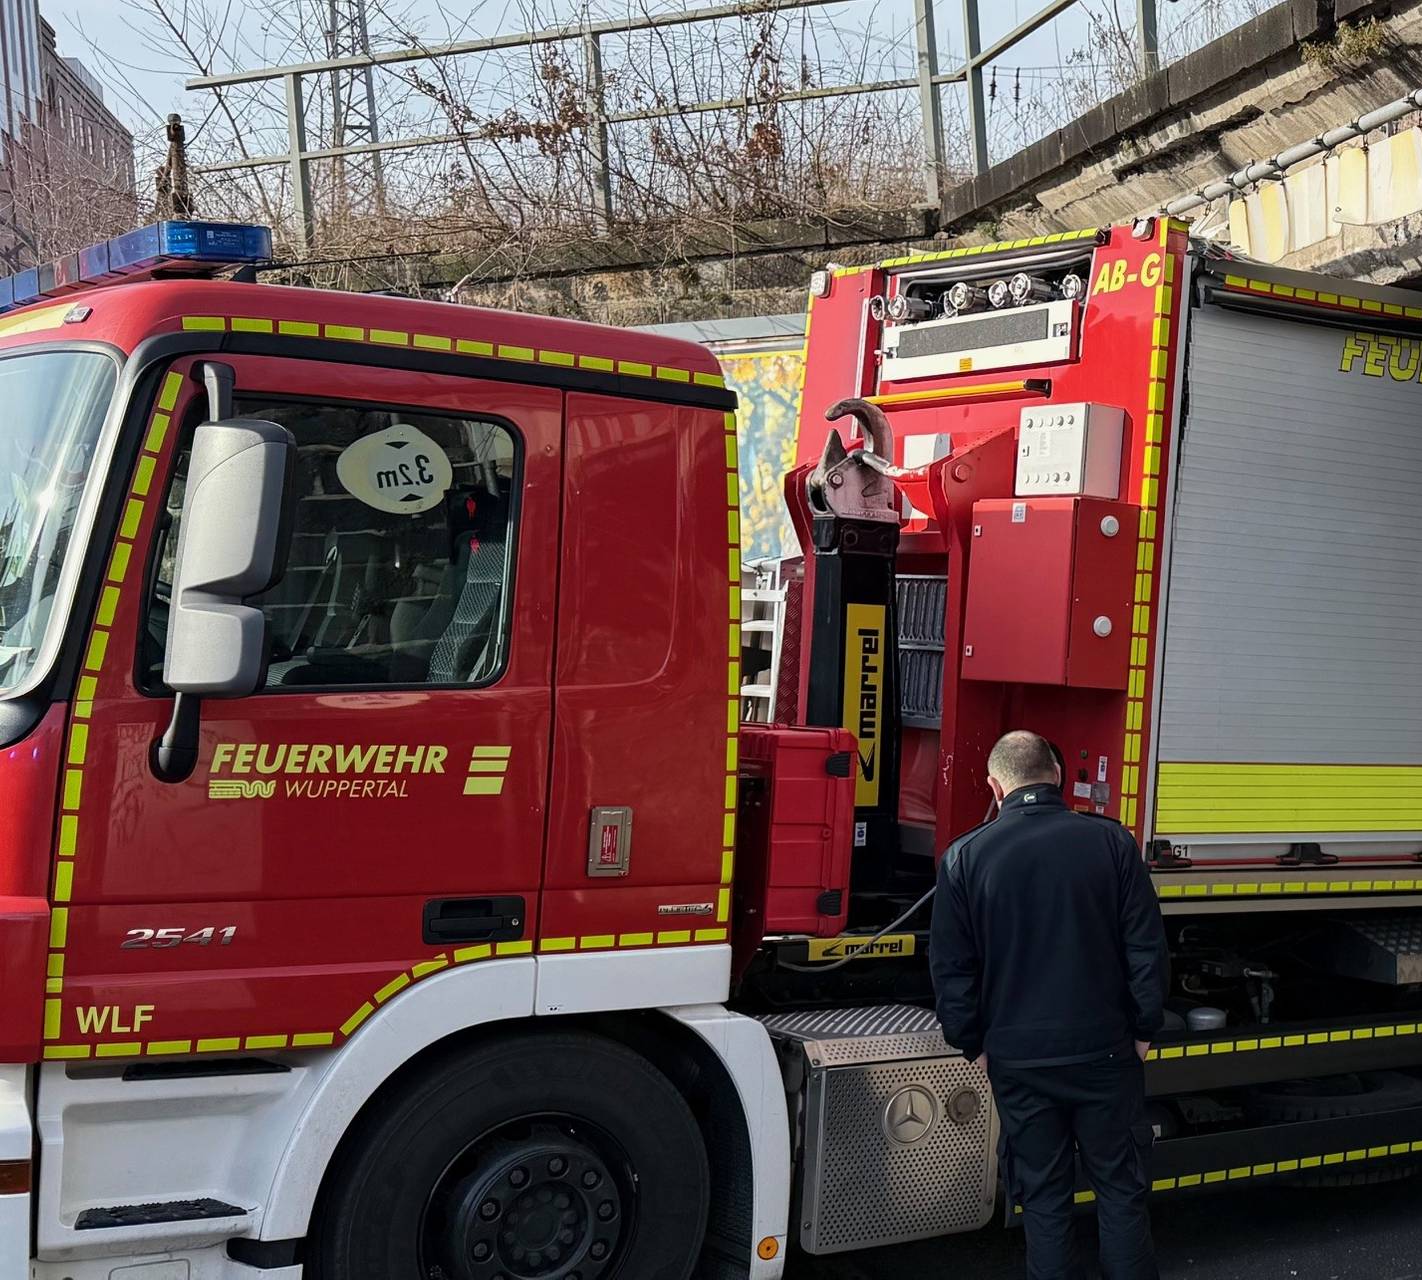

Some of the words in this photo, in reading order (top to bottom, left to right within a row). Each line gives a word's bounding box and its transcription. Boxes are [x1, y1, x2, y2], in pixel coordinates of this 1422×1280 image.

[1092, 253, 1160, 296] AB-G
[858, 628, 879, 739] marrel
[209, 744, 449, 774] FEUERWEHR
[285, 780, 409, 798] WUPPERTAL
[121, 926, 237, 949] 2541
[76, 1005, 155, 1034] WLF
